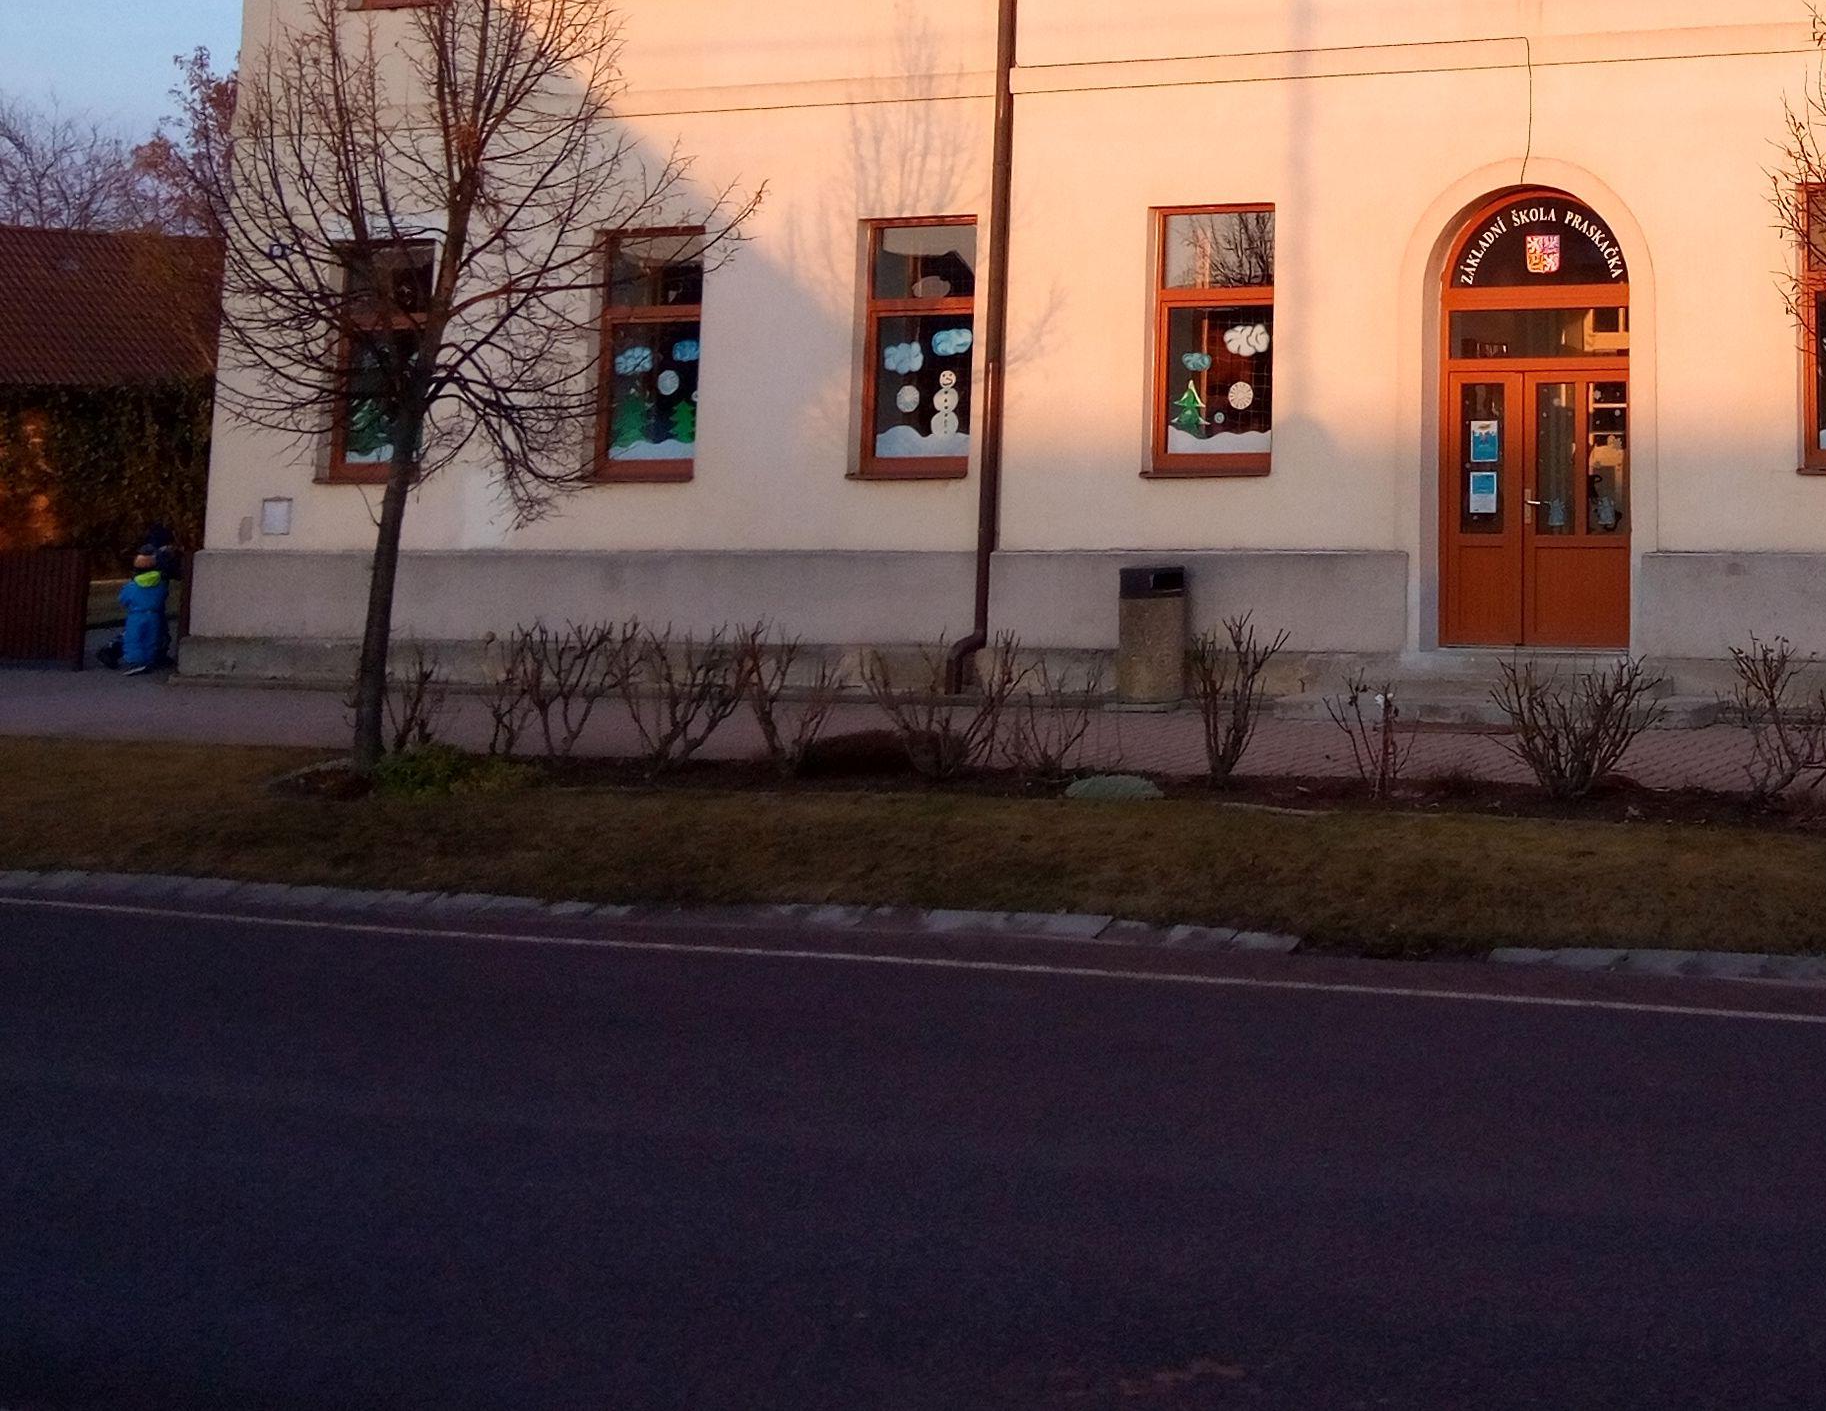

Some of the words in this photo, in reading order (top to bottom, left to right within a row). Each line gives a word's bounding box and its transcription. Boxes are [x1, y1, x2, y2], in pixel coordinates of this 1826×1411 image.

[1460, 216, 1507, 285] ZÁKLADNÍ
[1511, 207, 1556, 227] ŠKOLA
[1564, 210, 1624, 279] PRASKAČKA
